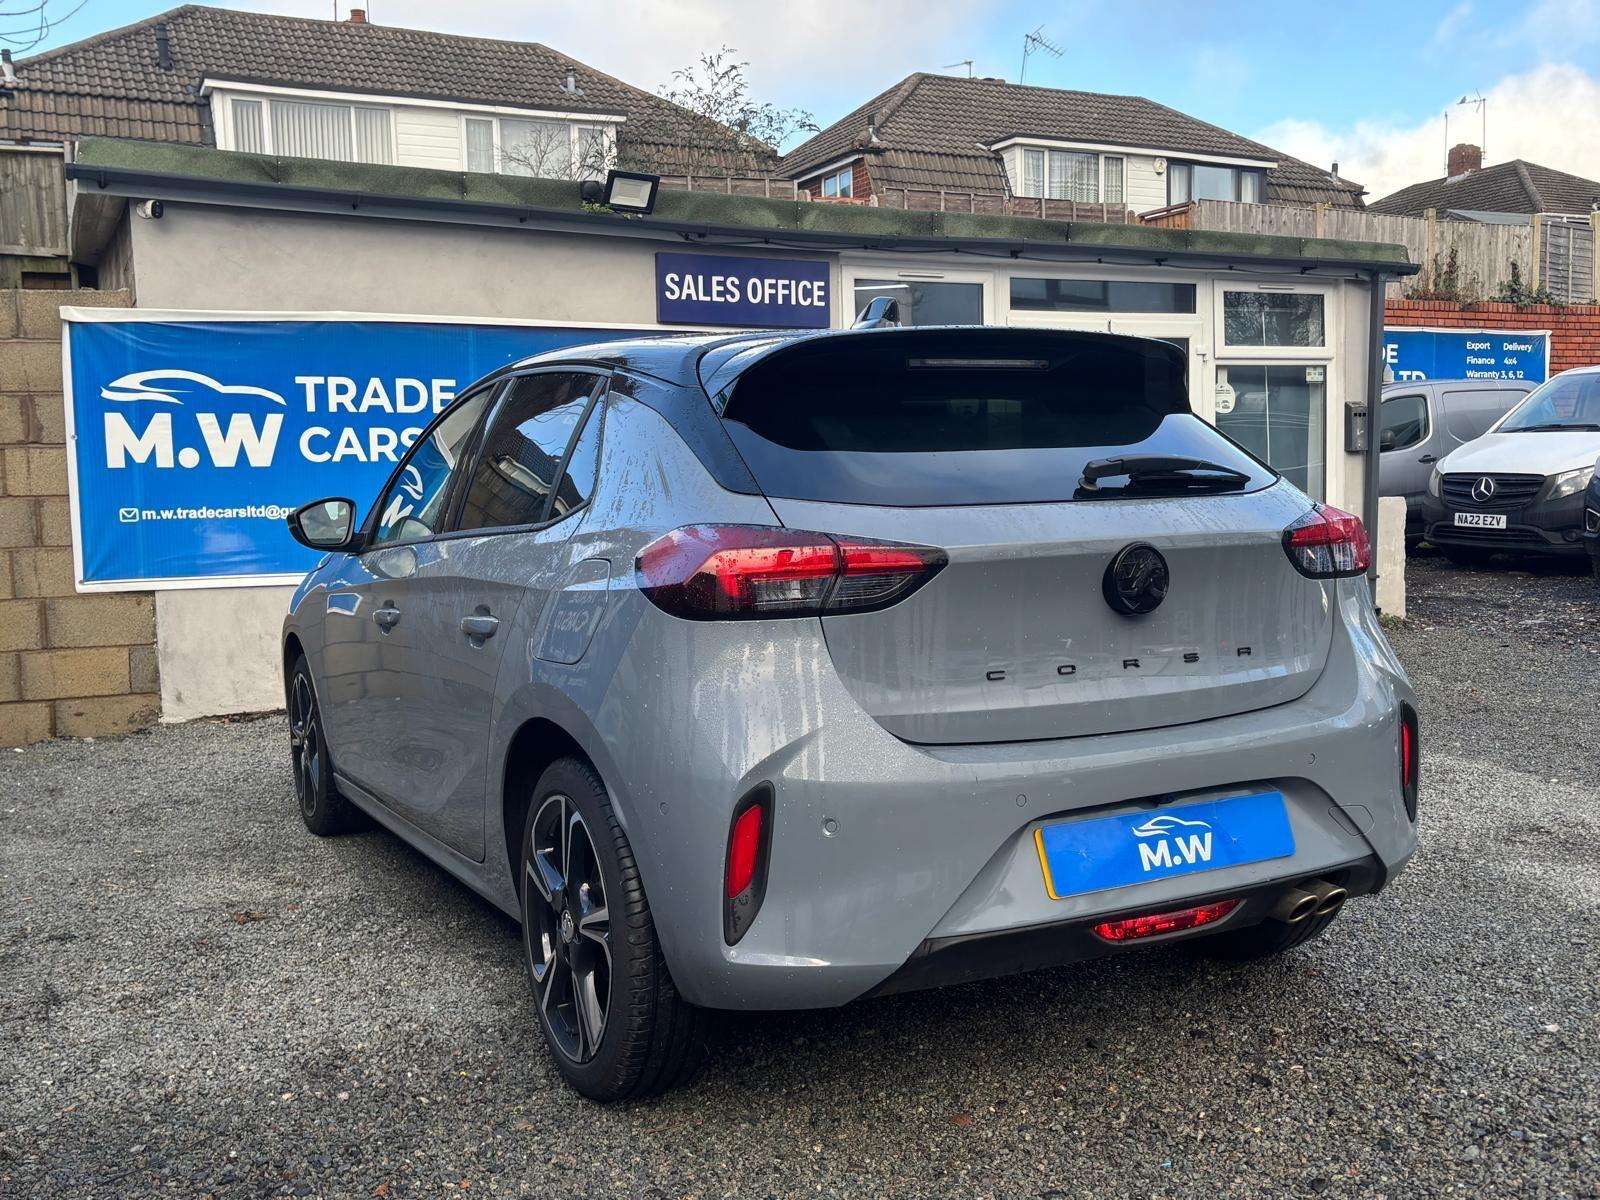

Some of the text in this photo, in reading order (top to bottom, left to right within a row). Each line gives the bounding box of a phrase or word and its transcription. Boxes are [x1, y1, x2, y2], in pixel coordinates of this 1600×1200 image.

[665, 273, 826, 307] SALES OFFICE
[1466, 341, 1533, 353] Export Delivery
[1466, 356, 1518, 365] Finance 4x4
[1392, 370, 1426, 381] TD
[1466, 370, 1500, 380] Warranty
[1516, 370, 1524, 379] 12
[294, 375, 457, 414] TRADE
[104, 412, 285, 469] M.W
[1457, 514, 1502, 527] NA22 EZV
[985, 646, 1252, 681] CORSA
[1138, 832, 1213, 872] M.W
